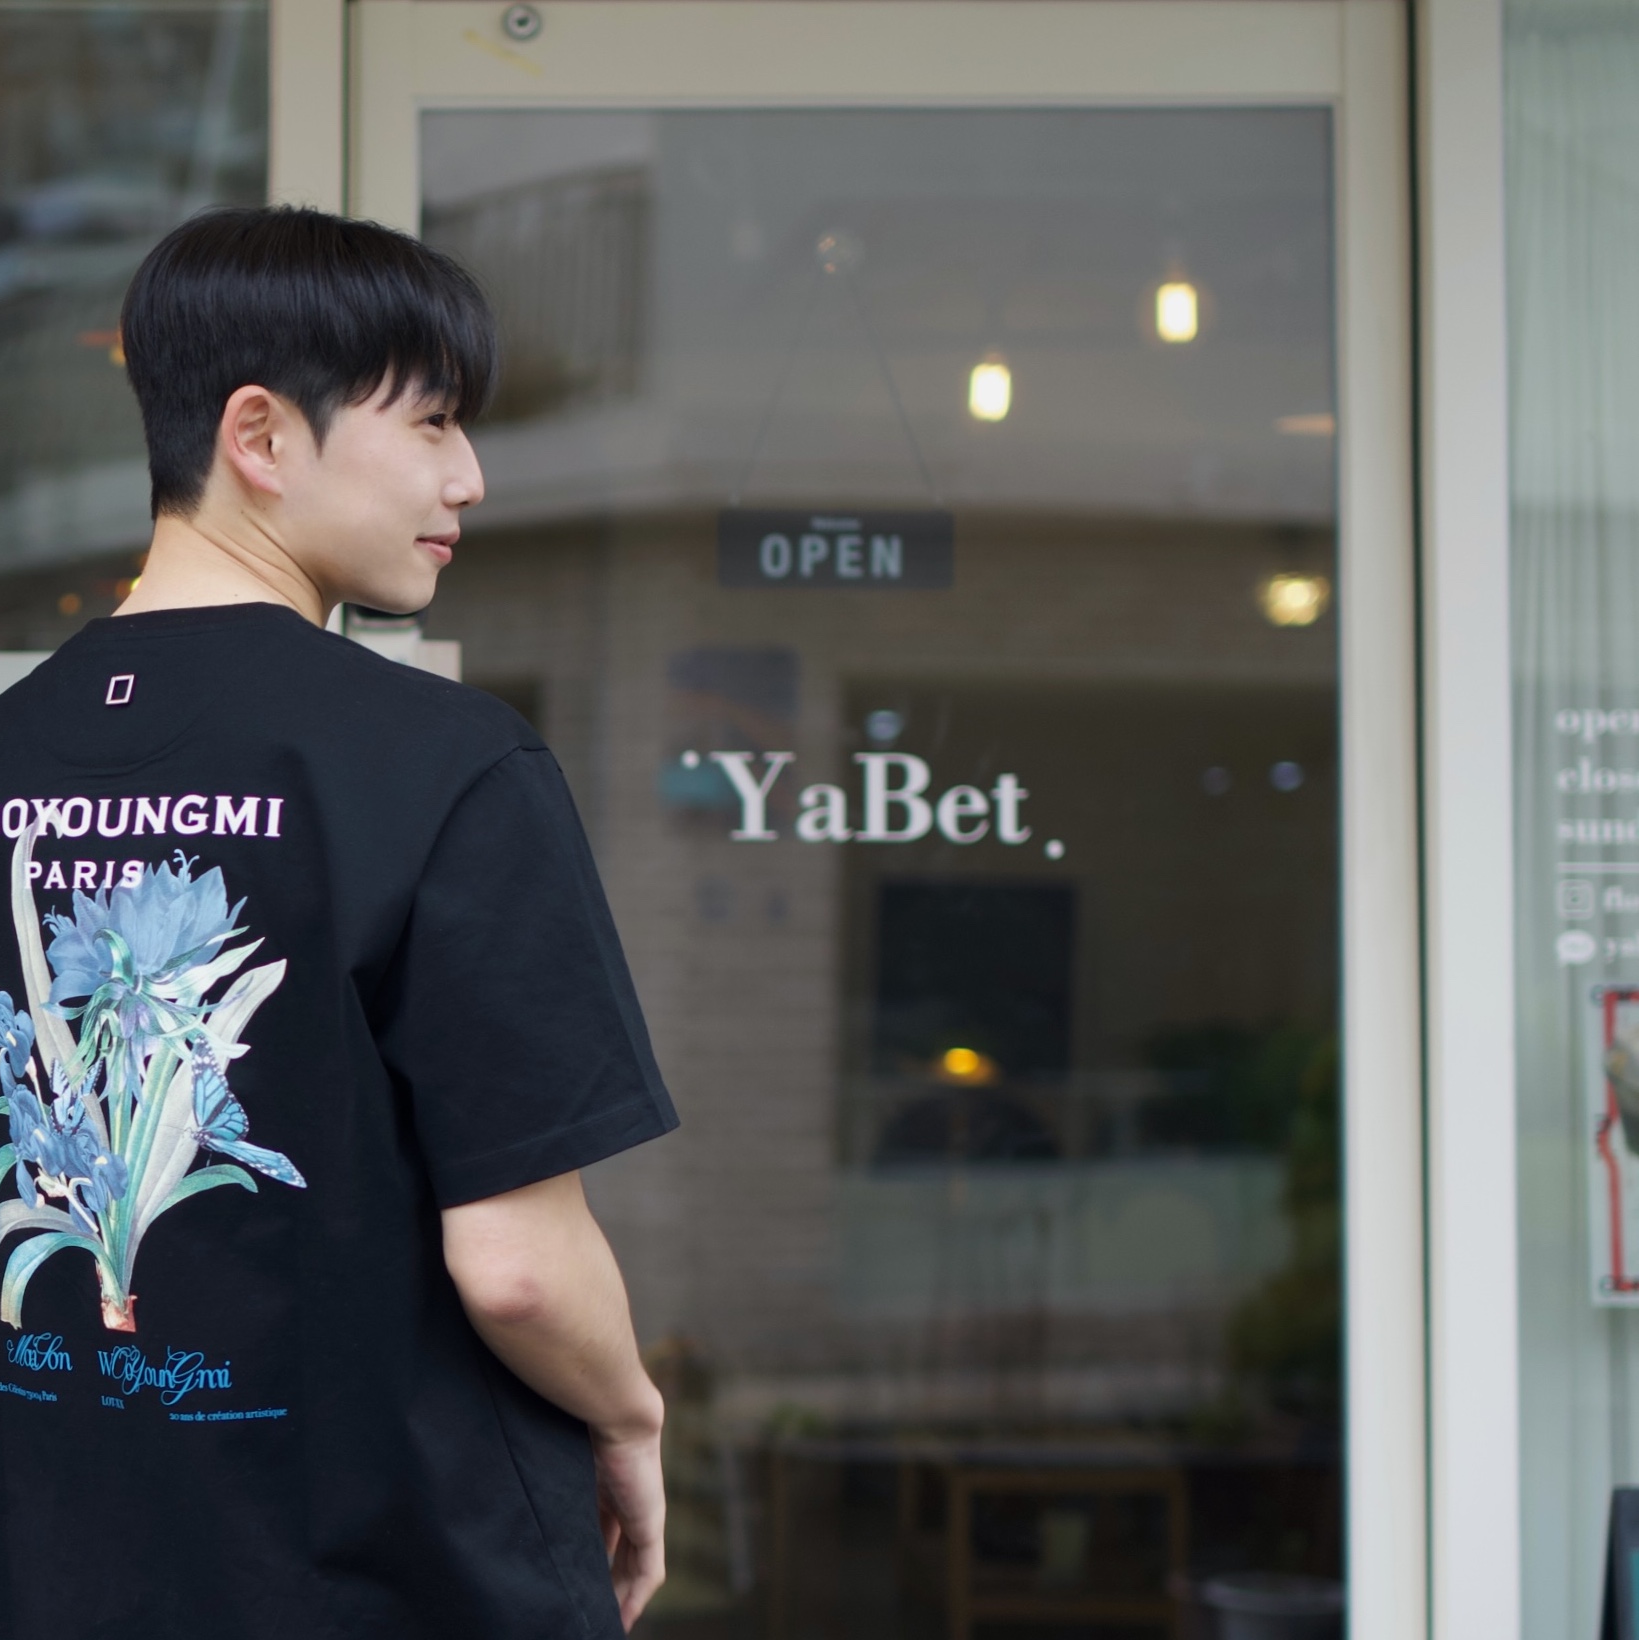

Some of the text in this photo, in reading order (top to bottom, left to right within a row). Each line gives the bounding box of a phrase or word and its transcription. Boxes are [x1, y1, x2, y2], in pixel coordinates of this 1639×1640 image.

[761, 533, 903, 578] OPEN
[1556, 708, 1639, 744] ope
[24, 859, 145, 889] PARIS
[195, 1411, 206, 1421] de
[245, 1407, 288, 1420] artistique
